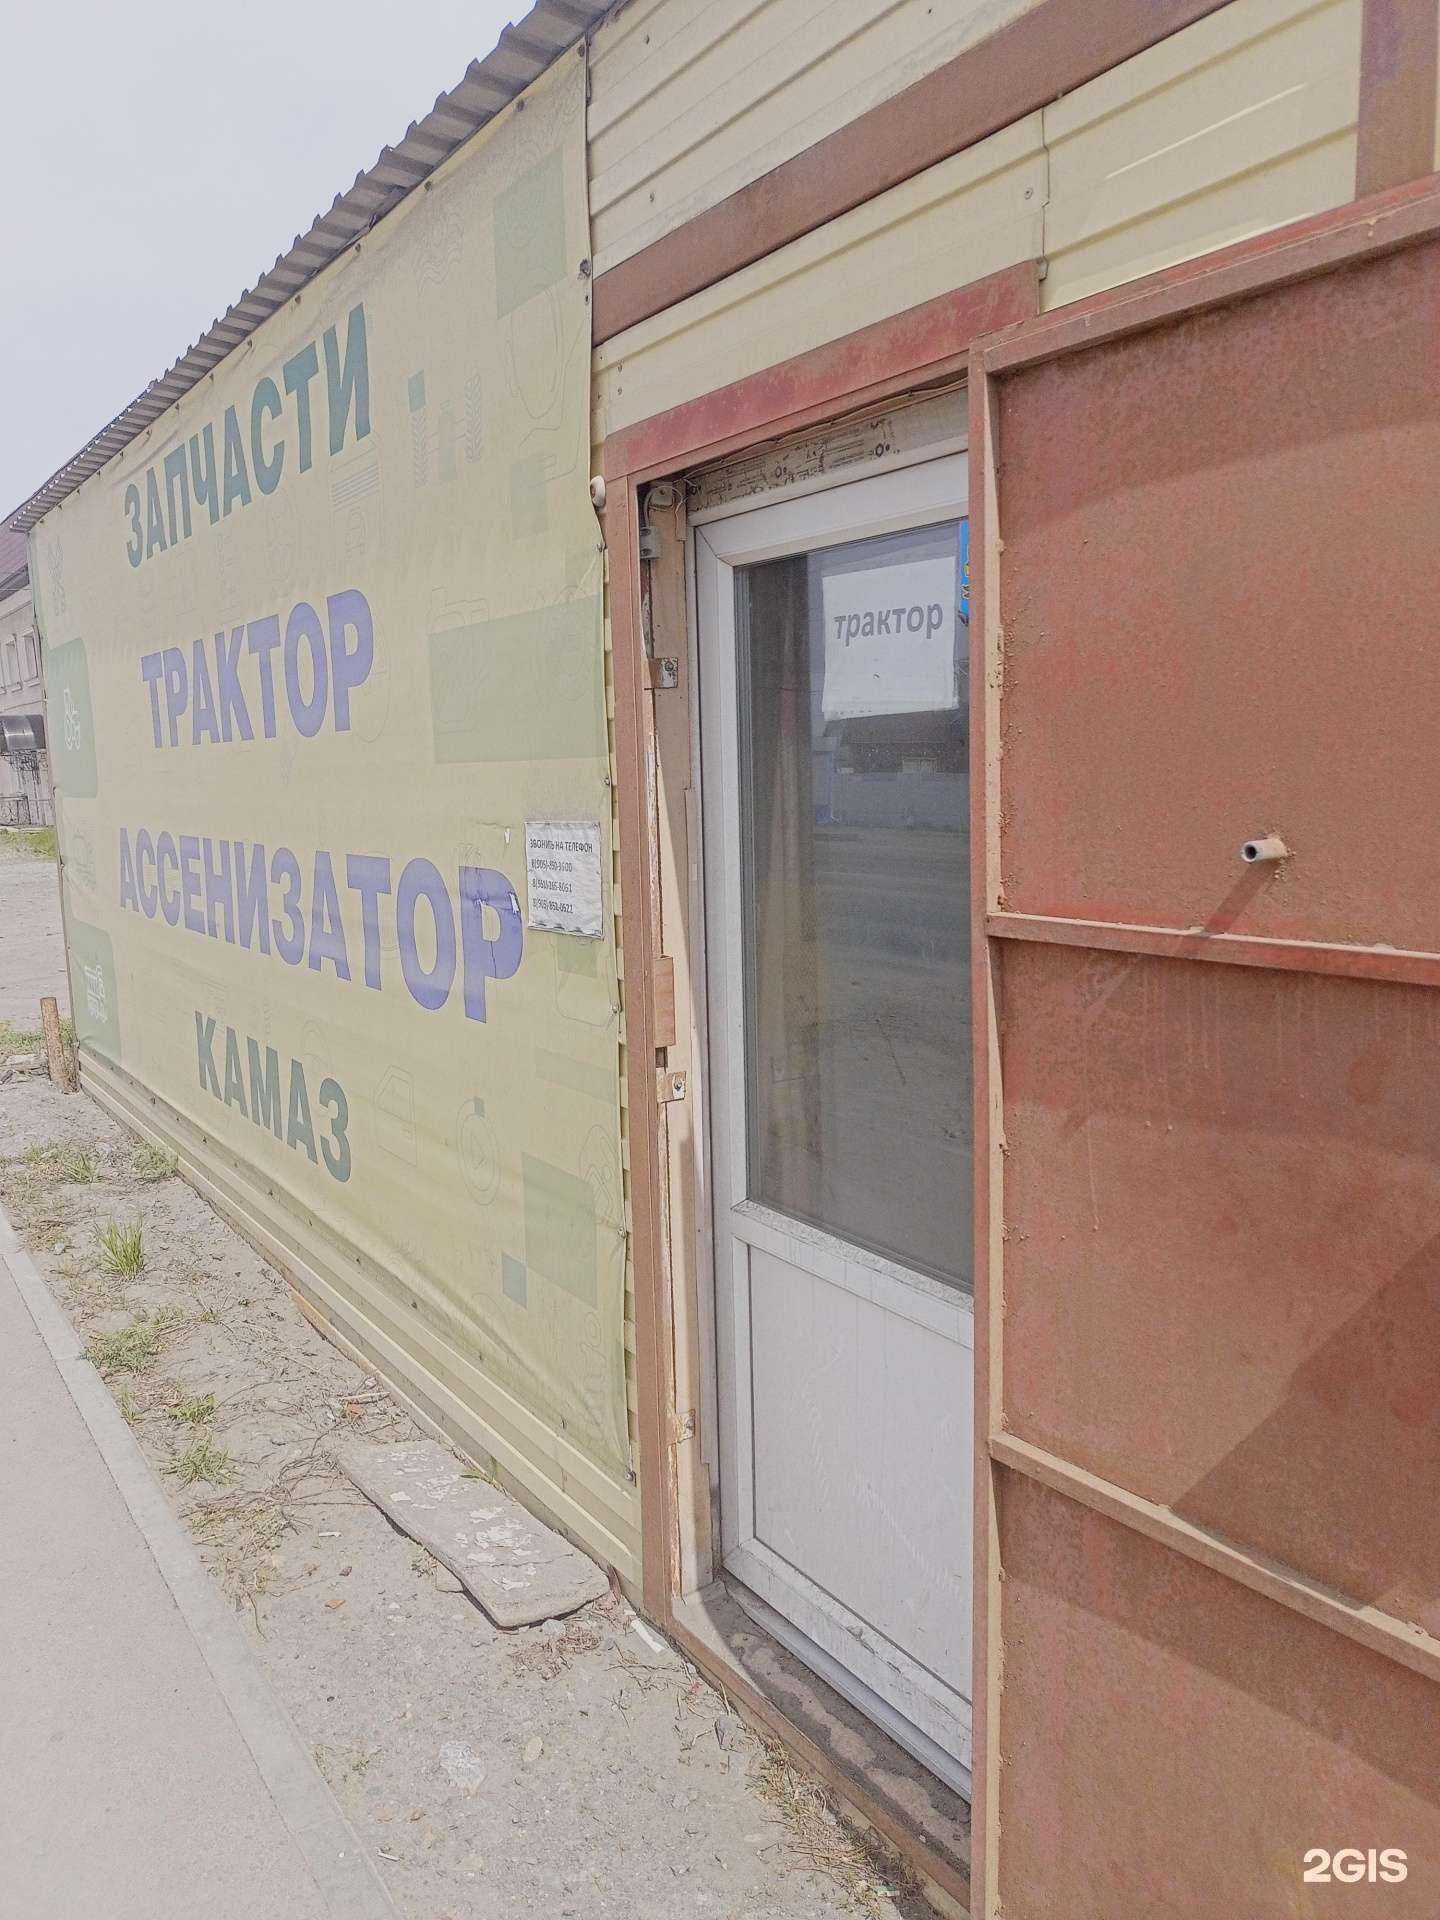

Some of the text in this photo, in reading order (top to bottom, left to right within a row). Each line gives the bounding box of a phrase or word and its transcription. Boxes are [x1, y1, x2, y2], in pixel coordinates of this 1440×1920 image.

[123, 301, 371, 569] ЗАПЧАСТИ
[140, 588, 374, 749] ТРАКТОР
[833, 603, 944, 647] трактор
[119, 827, 524, 1024] АССЕНИЗАТОР
[530, 838, 593, 853] ЗВОНИТЬ НА ТЕЛЕФОН
[195, 1010, 351, 1183] КАМАЗ
